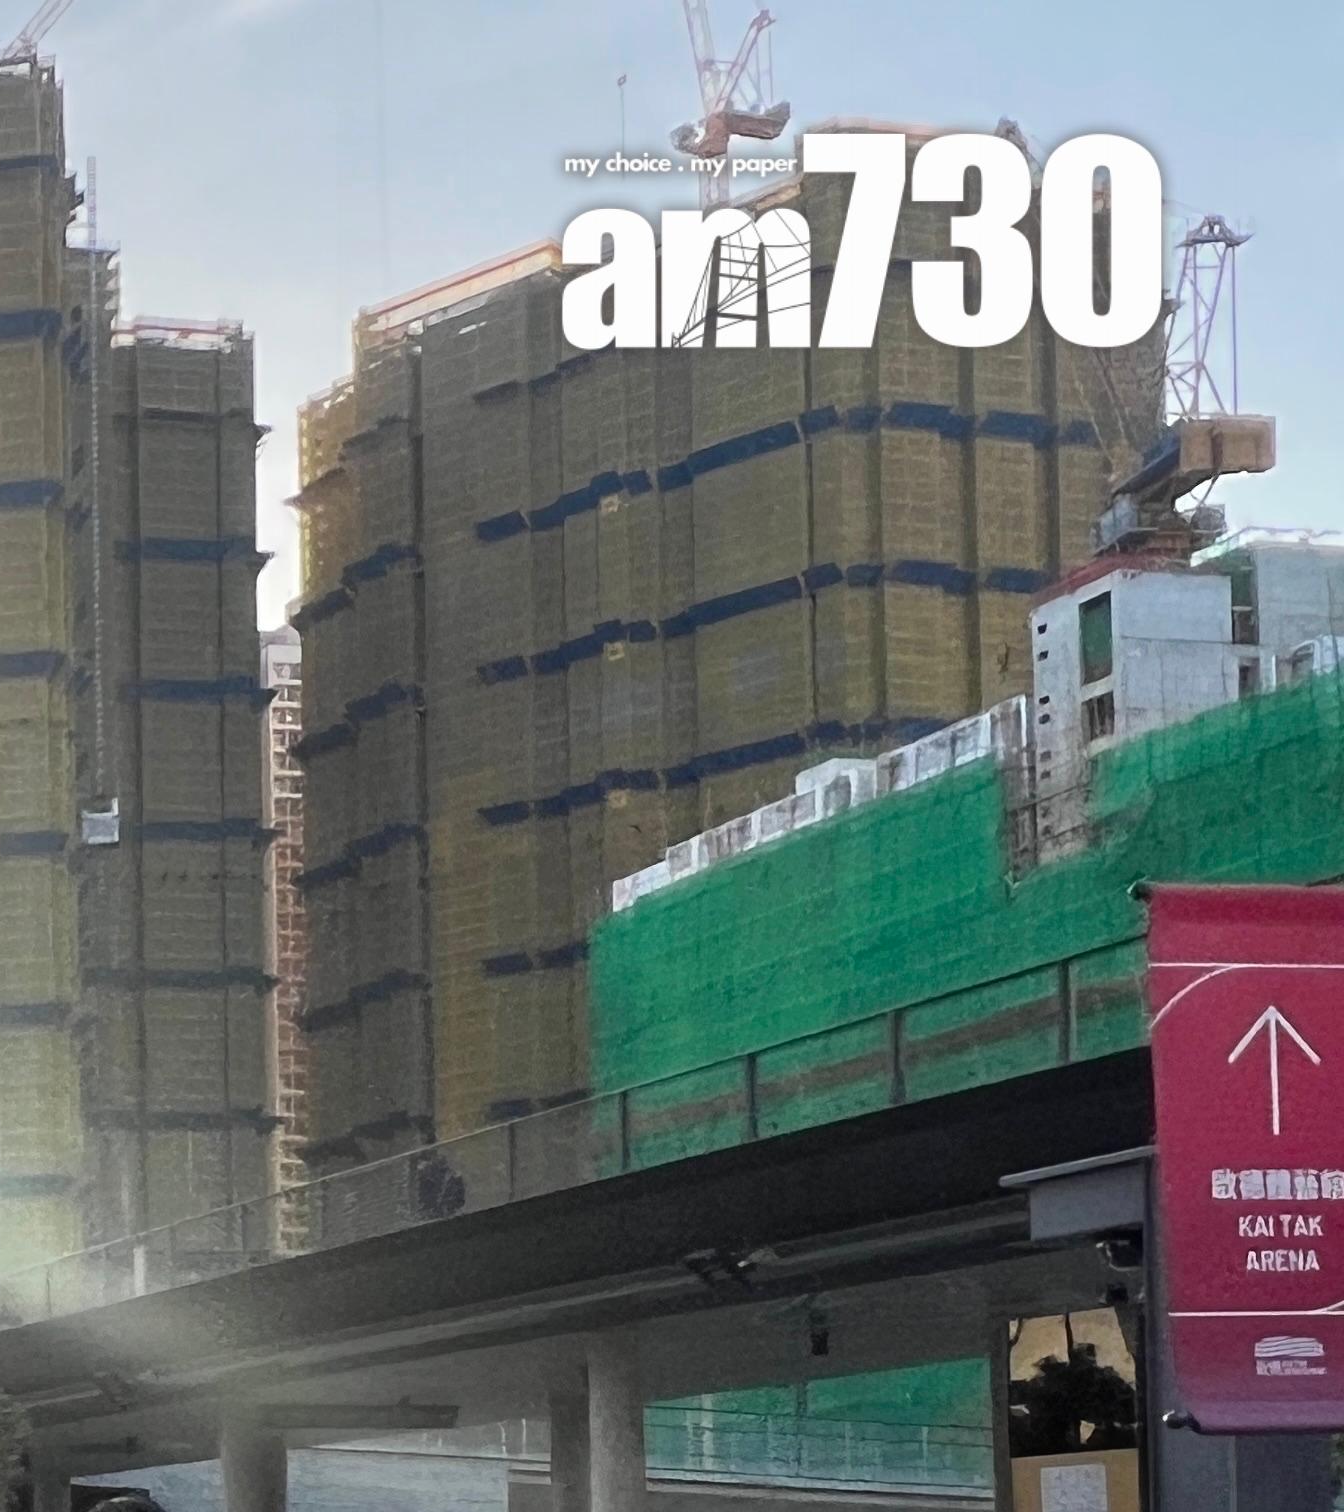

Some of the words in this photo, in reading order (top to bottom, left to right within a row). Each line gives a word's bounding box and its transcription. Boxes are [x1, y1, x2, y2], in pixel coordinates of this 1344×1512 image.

[1238, 1214, 1275, 1238] KAI
[1279, 1214, 1324, 1238] TAK
[1246, 1248, 1320, 1272] ARENA
